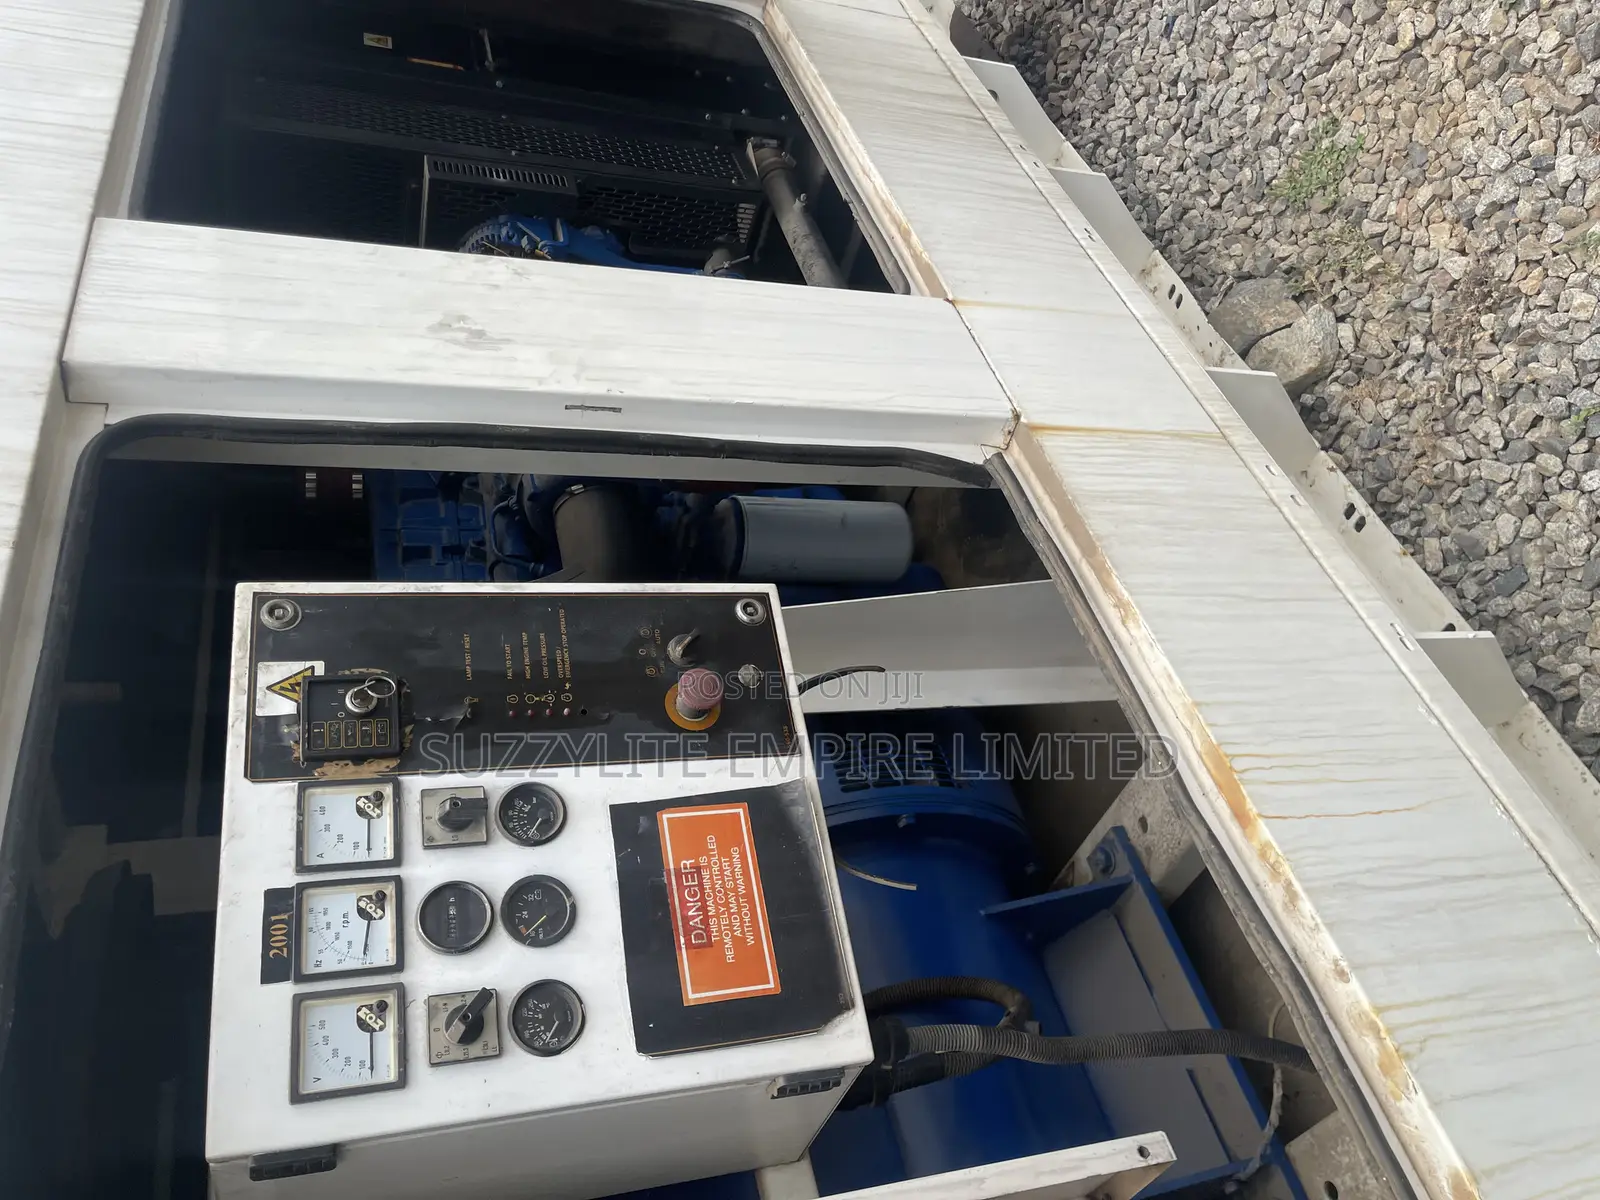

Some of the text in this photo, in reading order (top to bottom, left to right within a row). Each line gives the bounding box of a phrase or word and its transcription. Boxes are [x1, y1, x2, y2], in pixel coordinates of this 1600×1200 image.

[559, 608, 567, 634] OPERATED
[504, 644, 512, 659] START
[556, 650, 564, 679] OVERSPEED
[318, 806, 326, 816] 400
[336, 834, 344, 844] 200
[352, 842, 360, 850] 100
[528, 894, 534, 902] 32
[680, 858, 707, 945] DANGER
[699, 856, 720, 942] THIS MACHINE IS
[707, 834, 735, 963] REMOTELY CONTROLLED
[721, 856, 741, 937] AND MAY START
[731, 847, 755, 946] WITHOUT WARNING
[522, 911, 528, 919] 24
[269, 914, 289, 959] 2001
[314, 959, 322, 968] Hz
[318, 1019, 326, 1030] 500
[322, 1035, 330, 1046] 400
